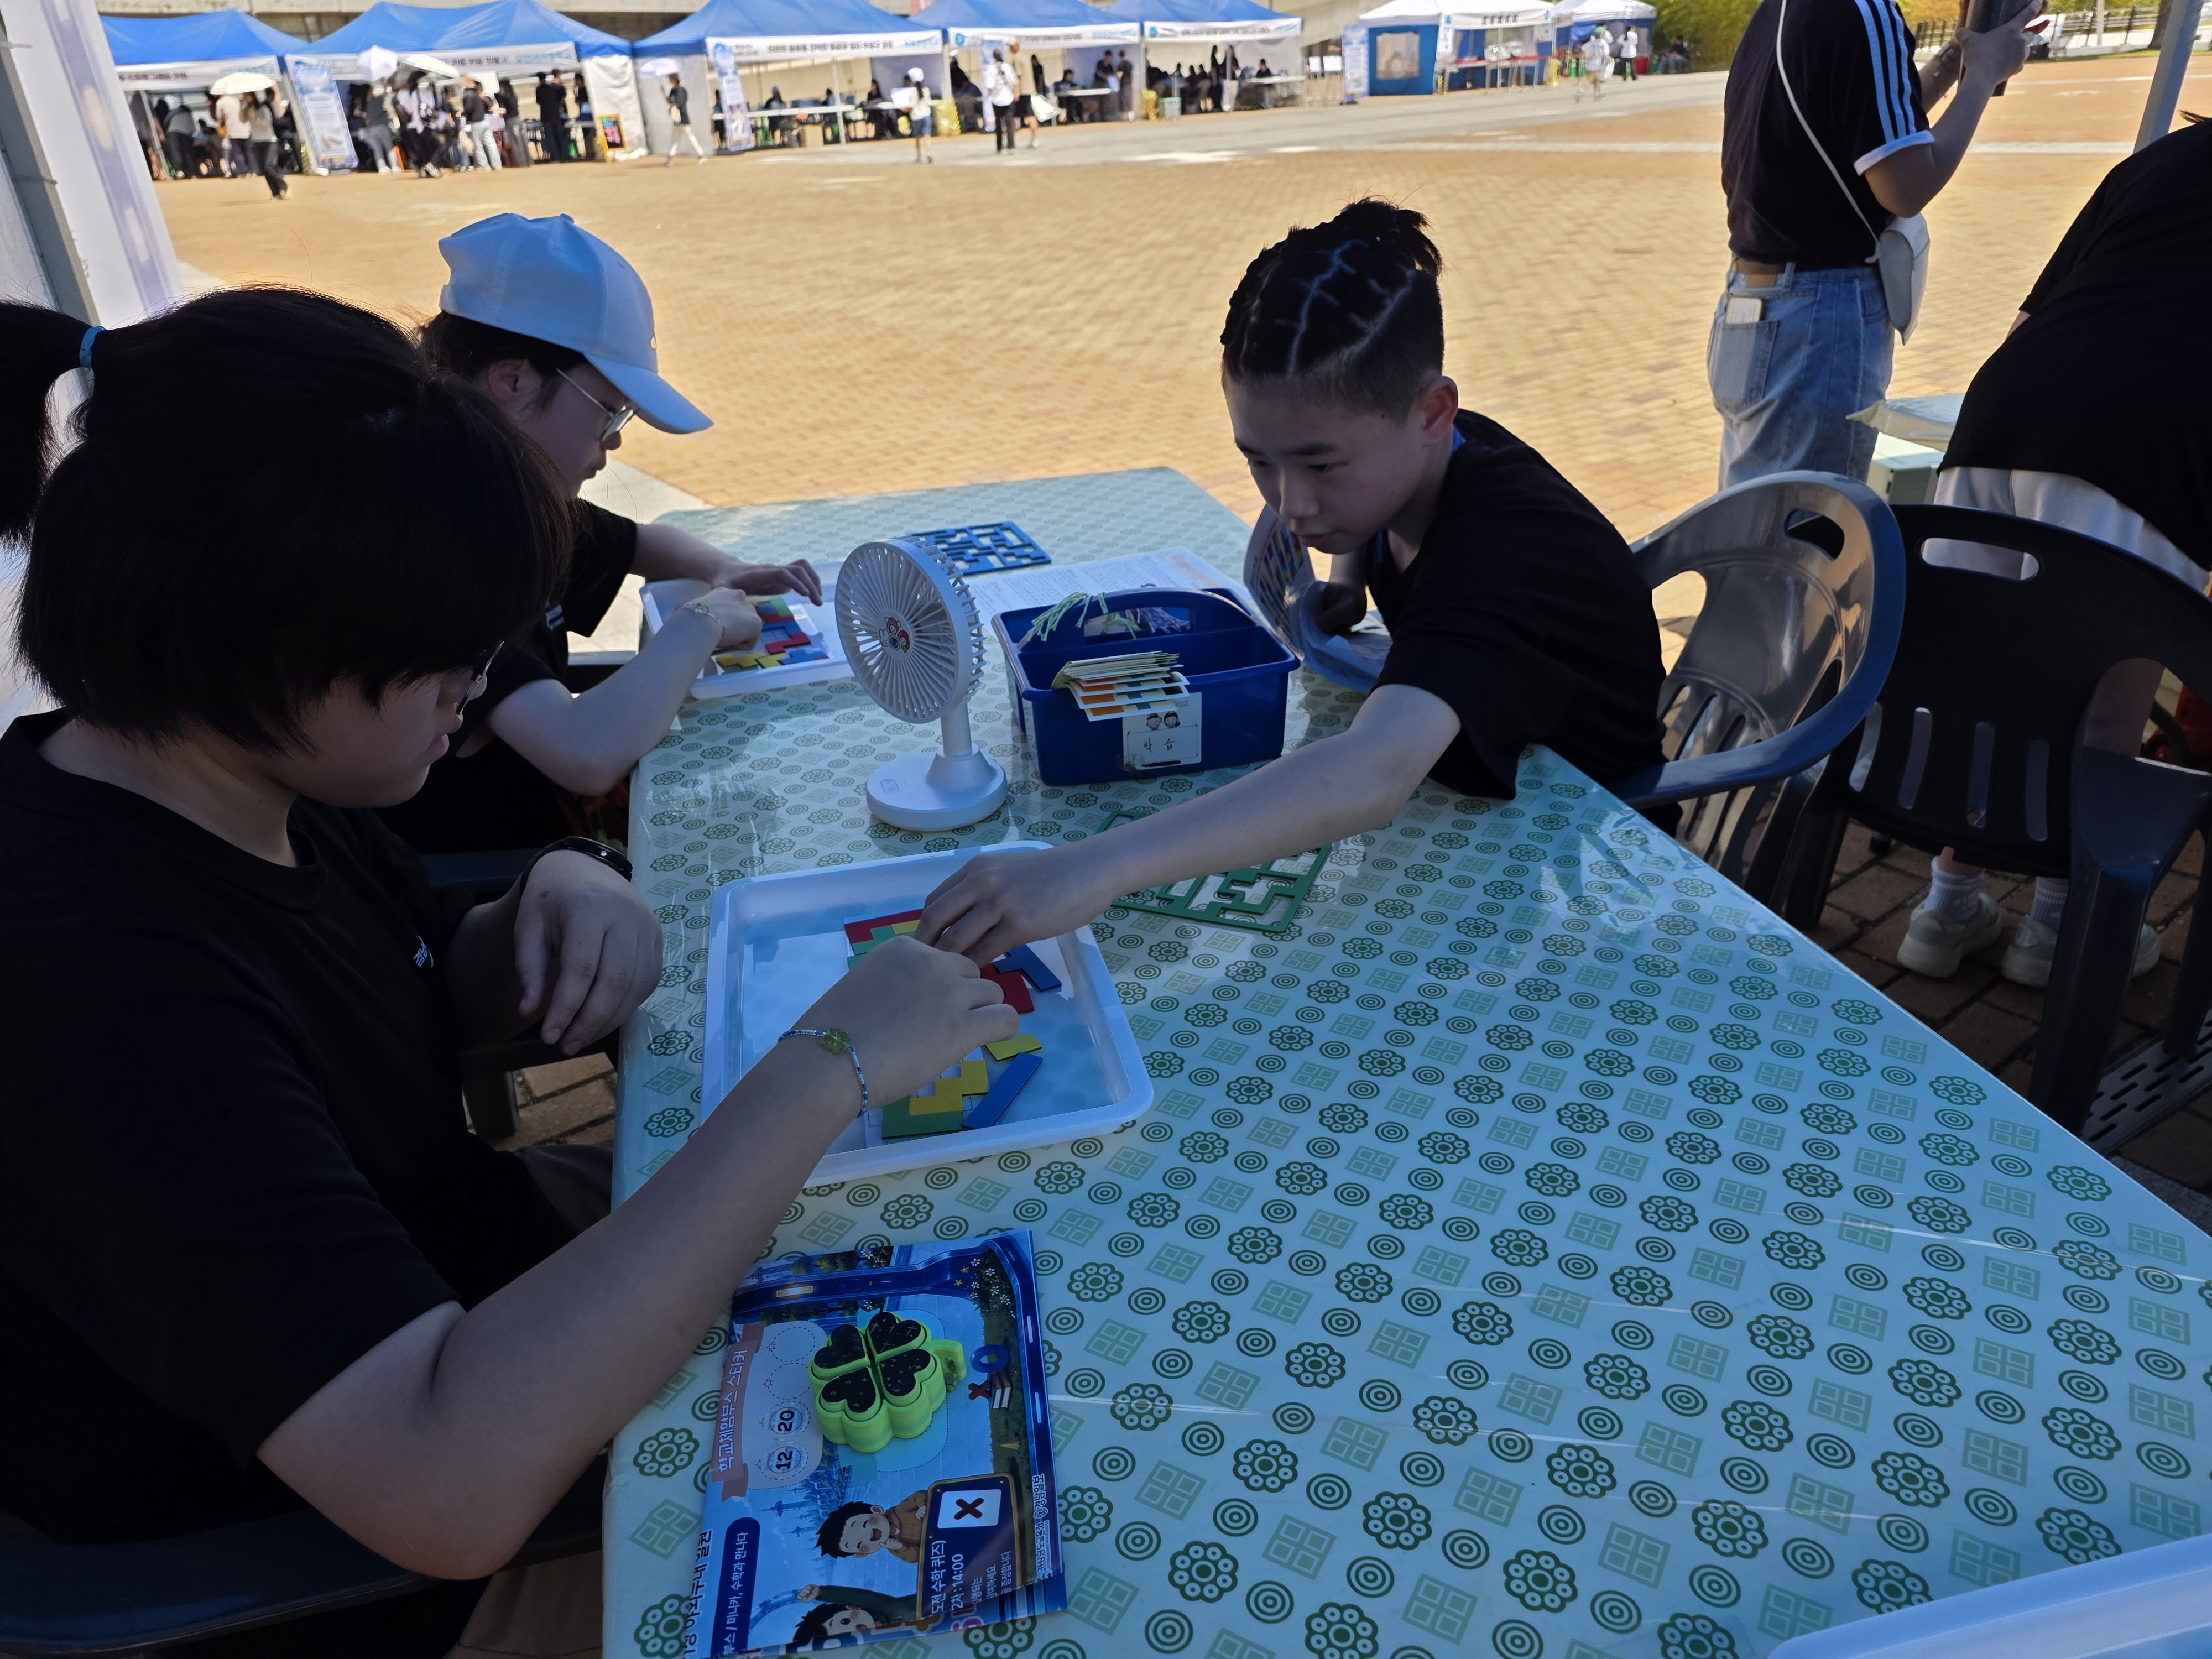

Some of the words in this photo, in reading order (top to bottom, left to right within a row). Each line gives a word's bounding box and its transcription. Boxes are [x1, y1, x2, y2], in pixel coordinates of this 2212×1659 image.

[726, 1349, 748, 1387] 스티커
[718, 1390, 738, 1472] 학교체험부스
[777, 1410, 795, 1432] 20
[775, 1451, 793, 1470] 12
[1033, 1474, 1046, 1509] 경남일보
[734, 1532, 749, 1560] 만나다
[930, 1540, 947, 1567] 퀴즈)
[1036, 1522, 1046, 1572] 경상남도교육청
[731, 1562, 745, 1590] 수학과
[930, 1569, 946, 1592] 수학
[1001, 1551, 1012, 1587] 증정합니다
[930, 1592, 946, 1614] 도전
[950, 1593, 964, 1610] 2차
